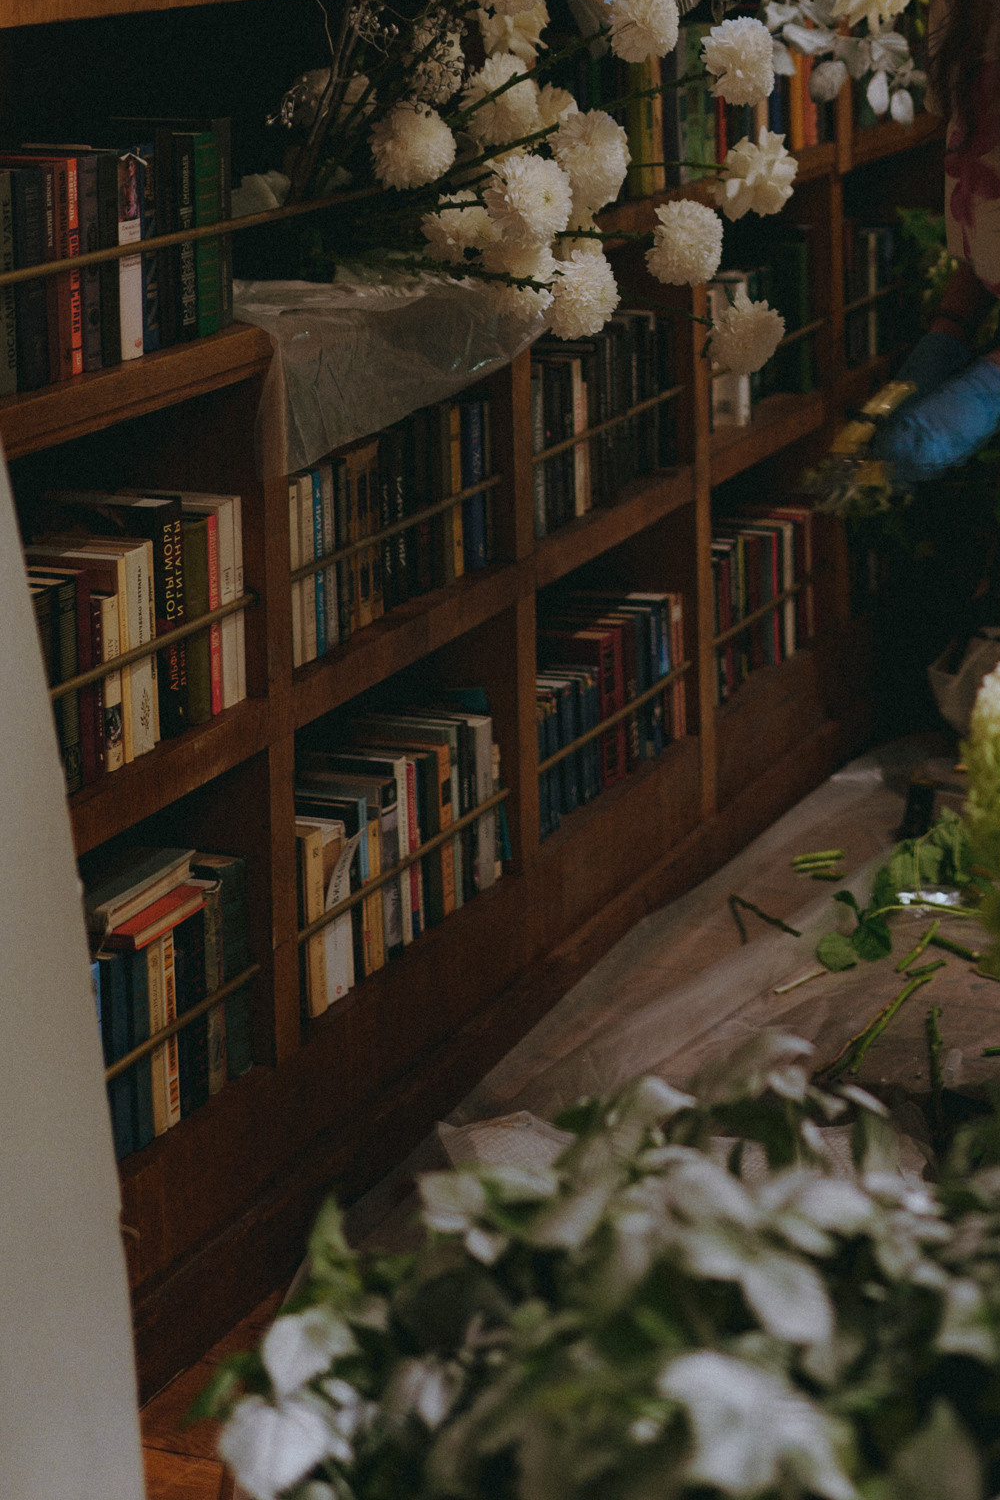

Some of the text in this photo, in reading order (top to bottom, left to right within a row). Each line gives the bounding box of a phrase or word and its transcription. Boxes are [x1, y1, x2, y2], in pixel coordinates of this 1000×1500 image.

[4, 280, 16, 369] ПОСЛЕДНИ
[163, 523, 176, 621] ГОРЫ МОРЯ
[173, 520, 184, 599] ГИГАНТЫ
[315, 504, 325, 584] КЛОКАИН
